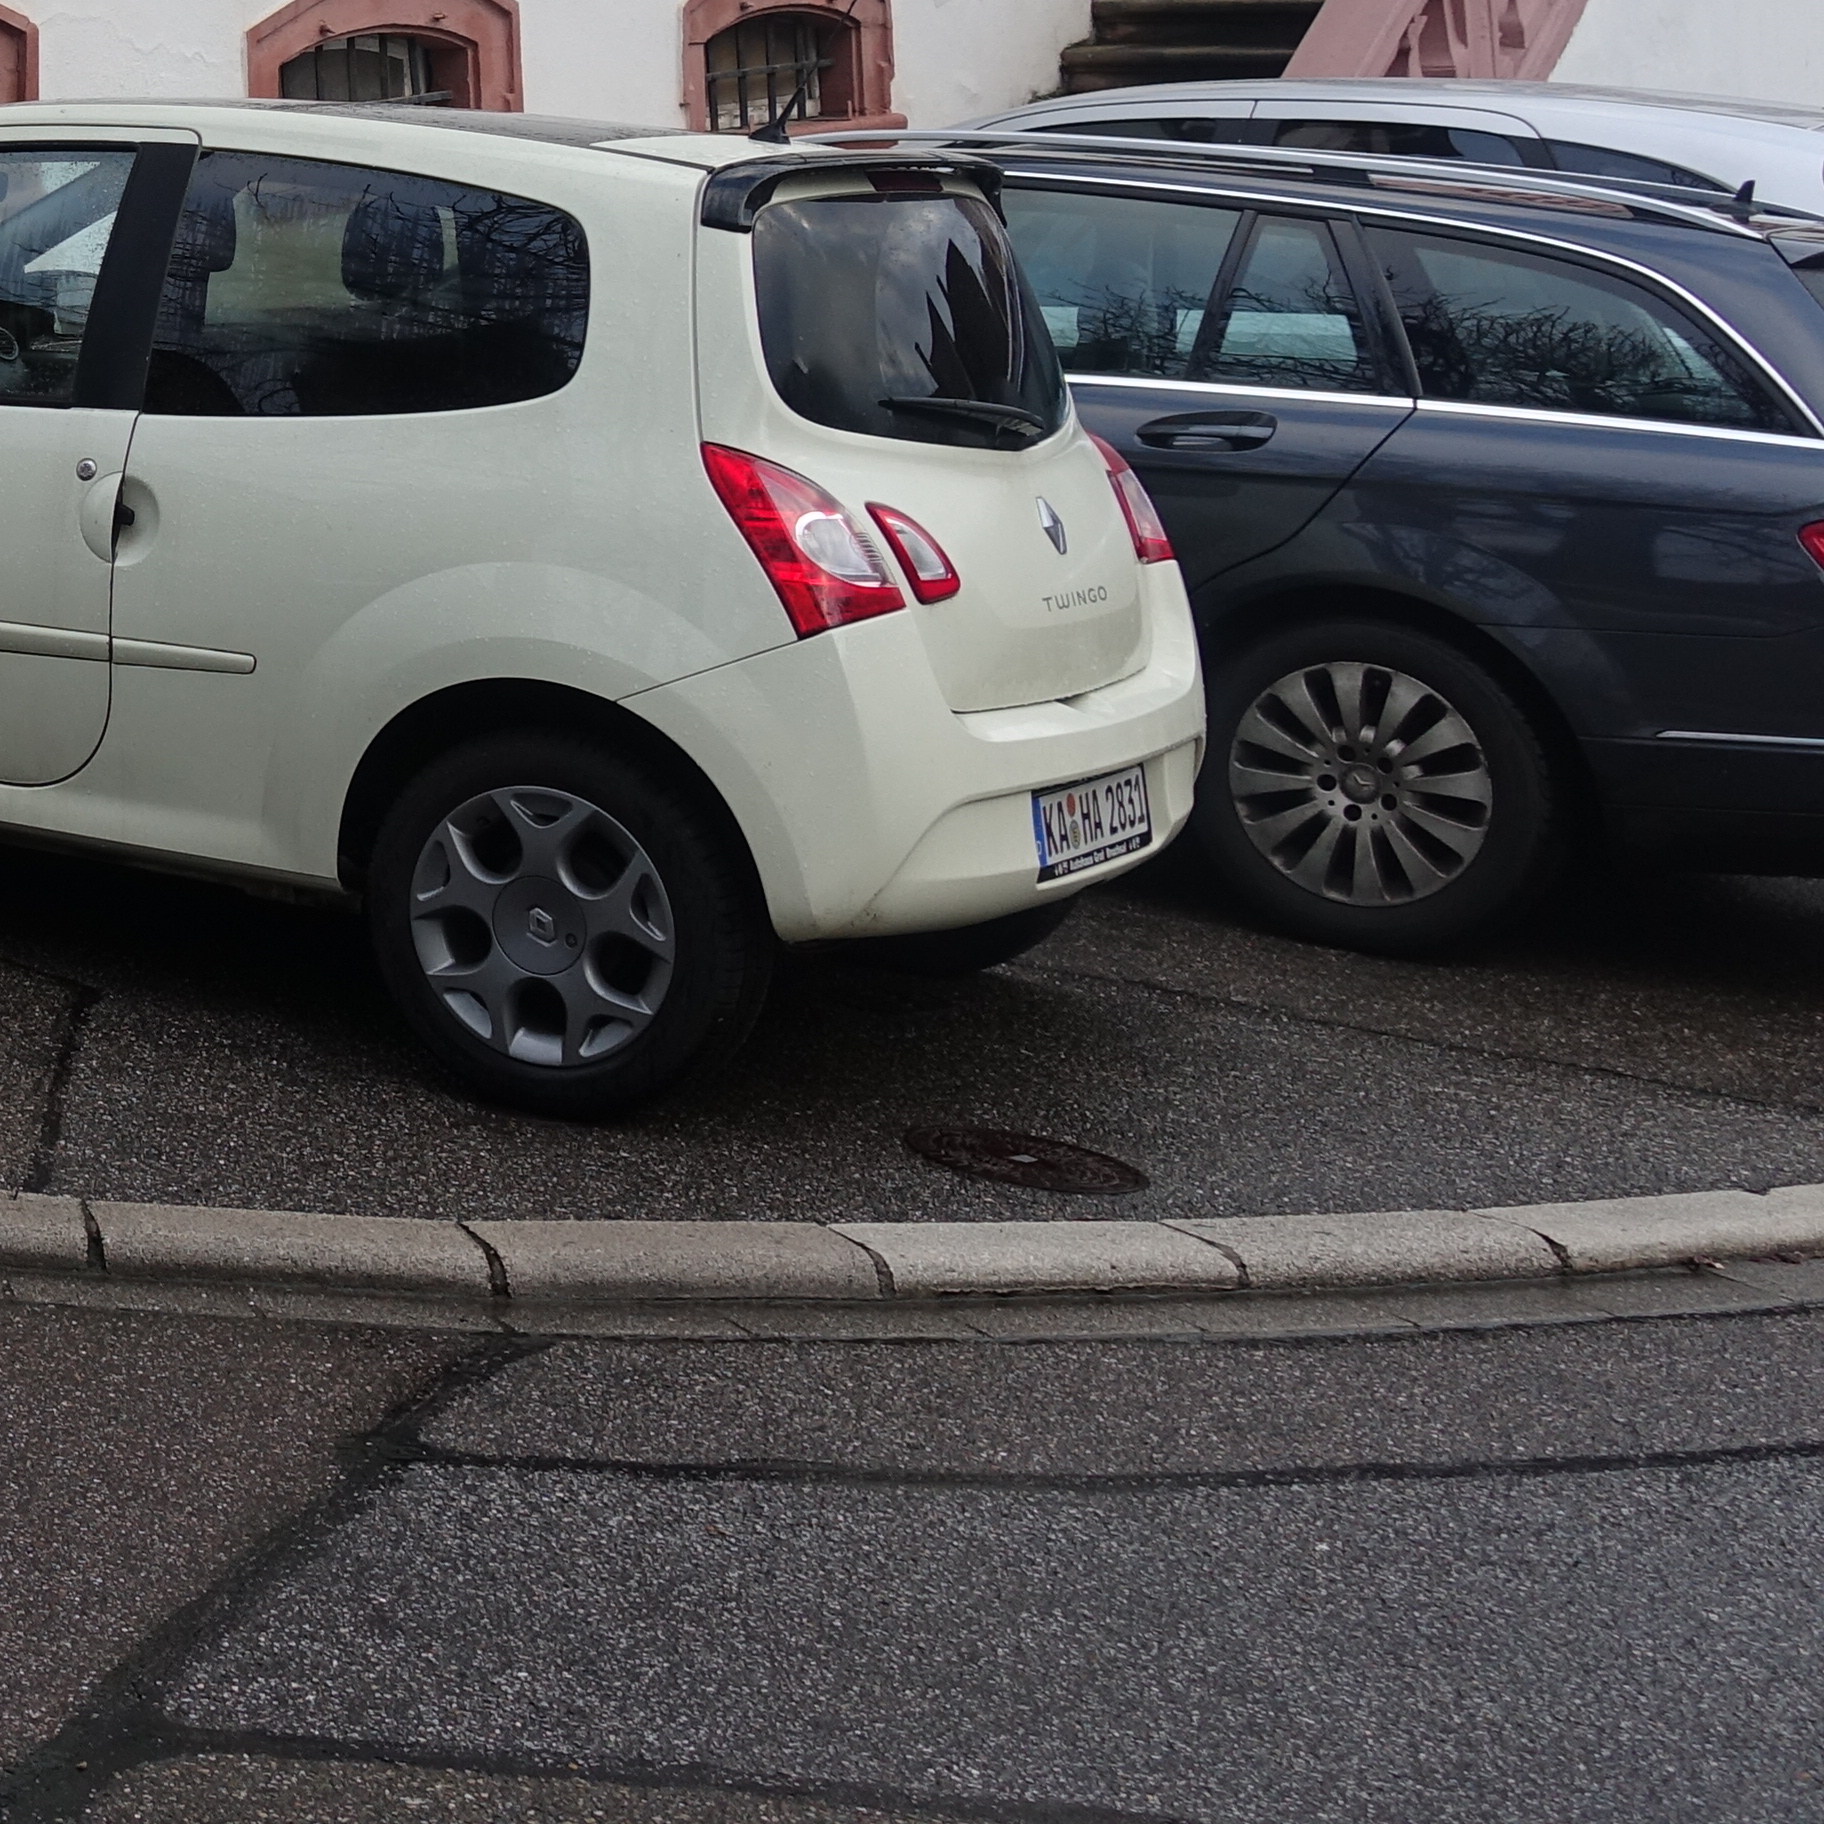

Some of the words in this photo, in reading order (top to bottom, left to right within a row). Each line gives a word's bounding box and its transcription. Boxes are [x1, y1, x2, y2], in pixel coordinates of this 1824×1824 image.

[1042, 585, 1107, 612] TWINGO
[1043, 801, 1070, 857] KA
[1079, 789, 1104, 845] HA
[1105, 774, 1145, 836] 2831
